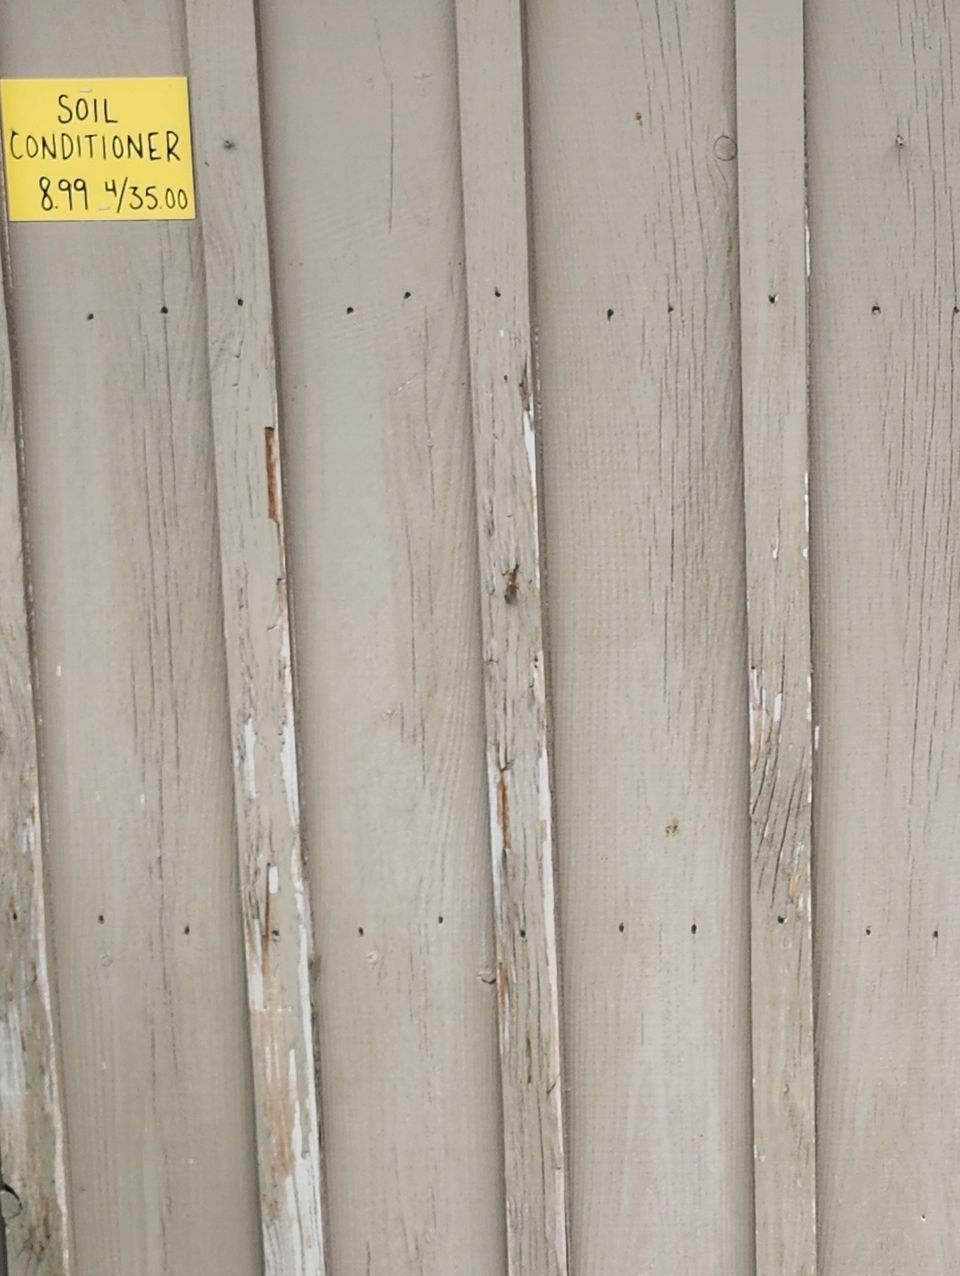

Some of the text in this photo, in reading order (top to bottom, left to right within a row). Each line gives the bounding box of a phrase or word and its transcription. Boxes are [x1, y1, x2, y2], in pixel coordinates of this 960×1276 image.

[58, 94, 118, 124] SOIL
[10, 129, 181, 162] CONDITIONER
[39, 176, 188, 214] 8.99 4/35.00
